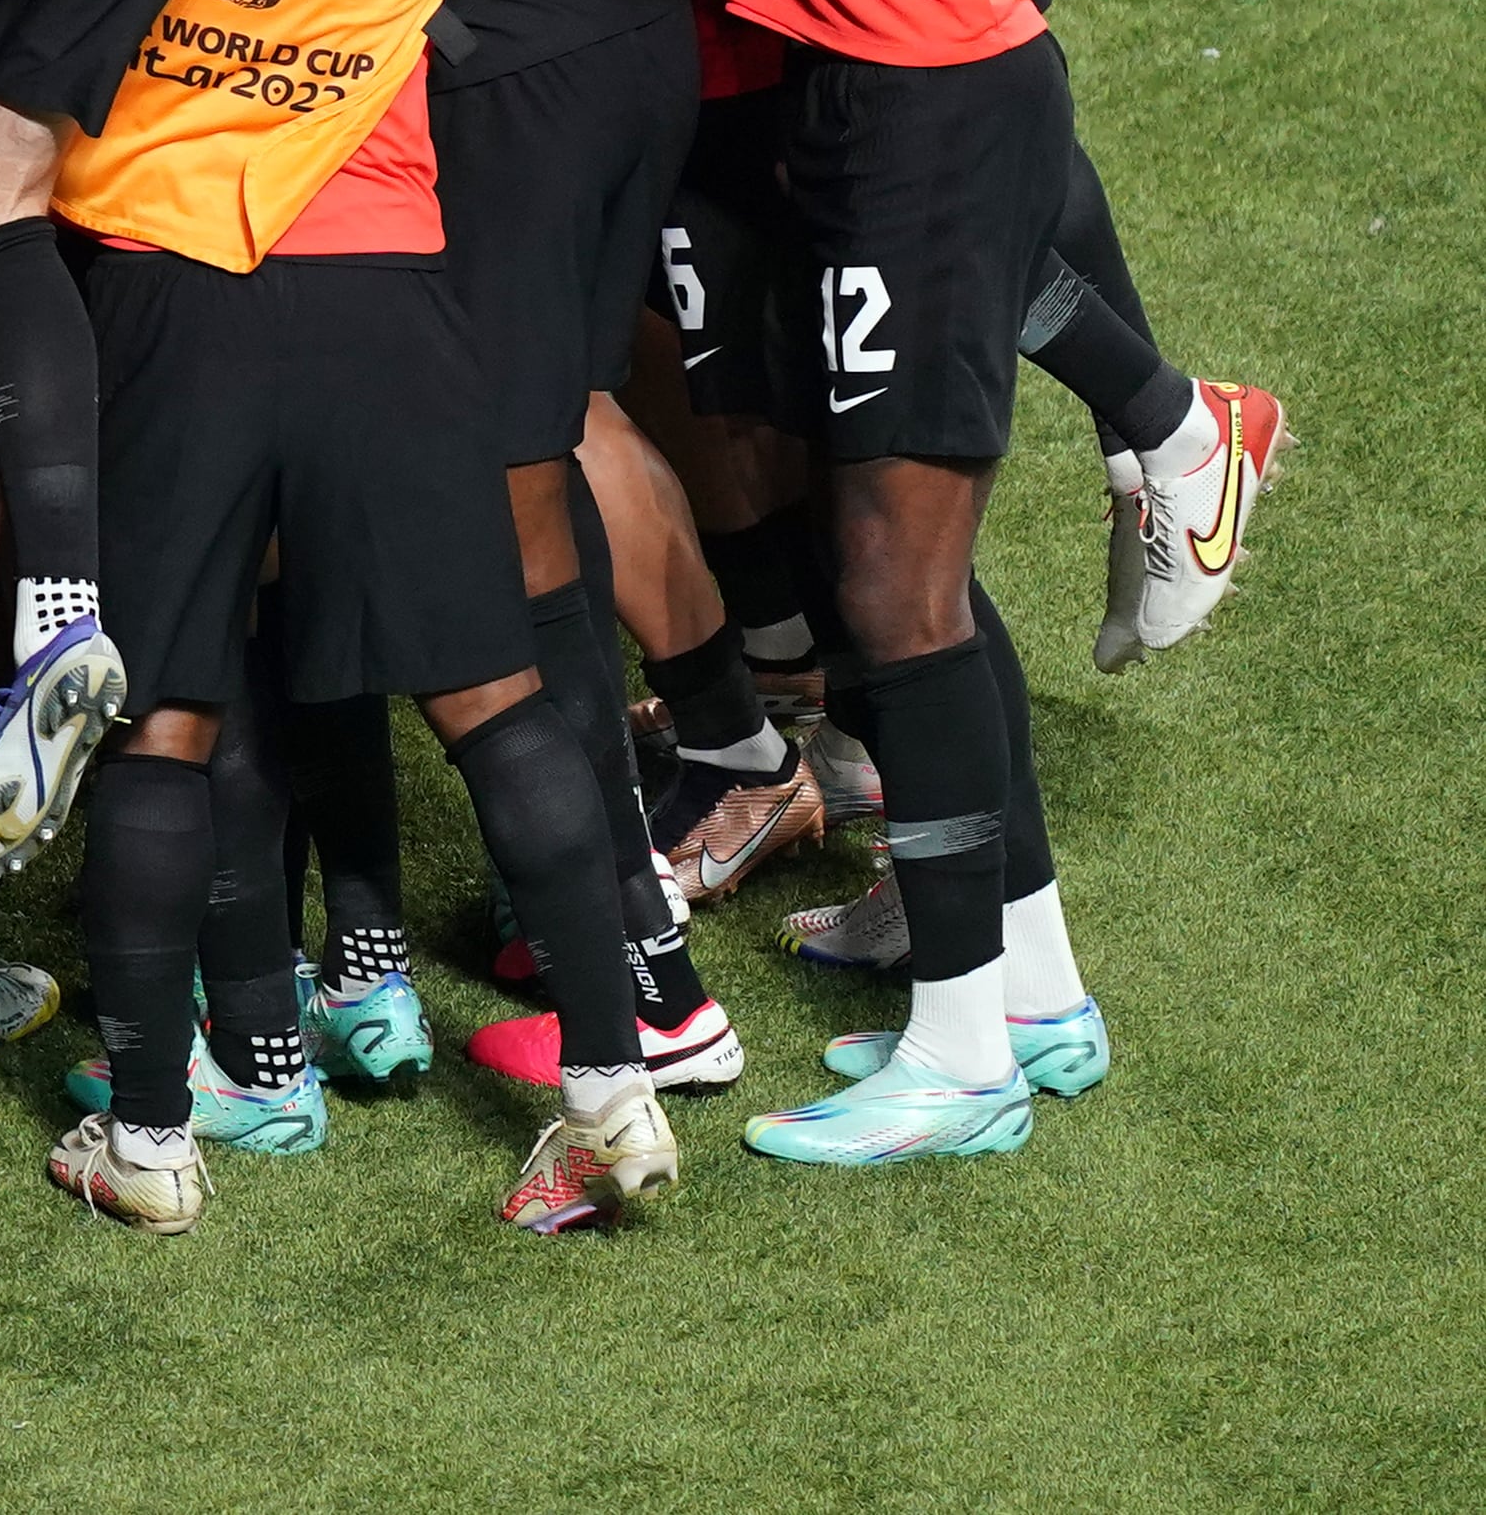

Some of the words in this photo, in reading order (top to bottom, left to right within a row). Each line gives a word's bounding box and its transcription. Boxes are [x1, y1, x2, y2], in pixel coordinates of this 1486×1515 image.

[162, 15, 300, 66] WORLD
[306, 48, 375, 80] CUP
[820, 266, 896, 372] 12
